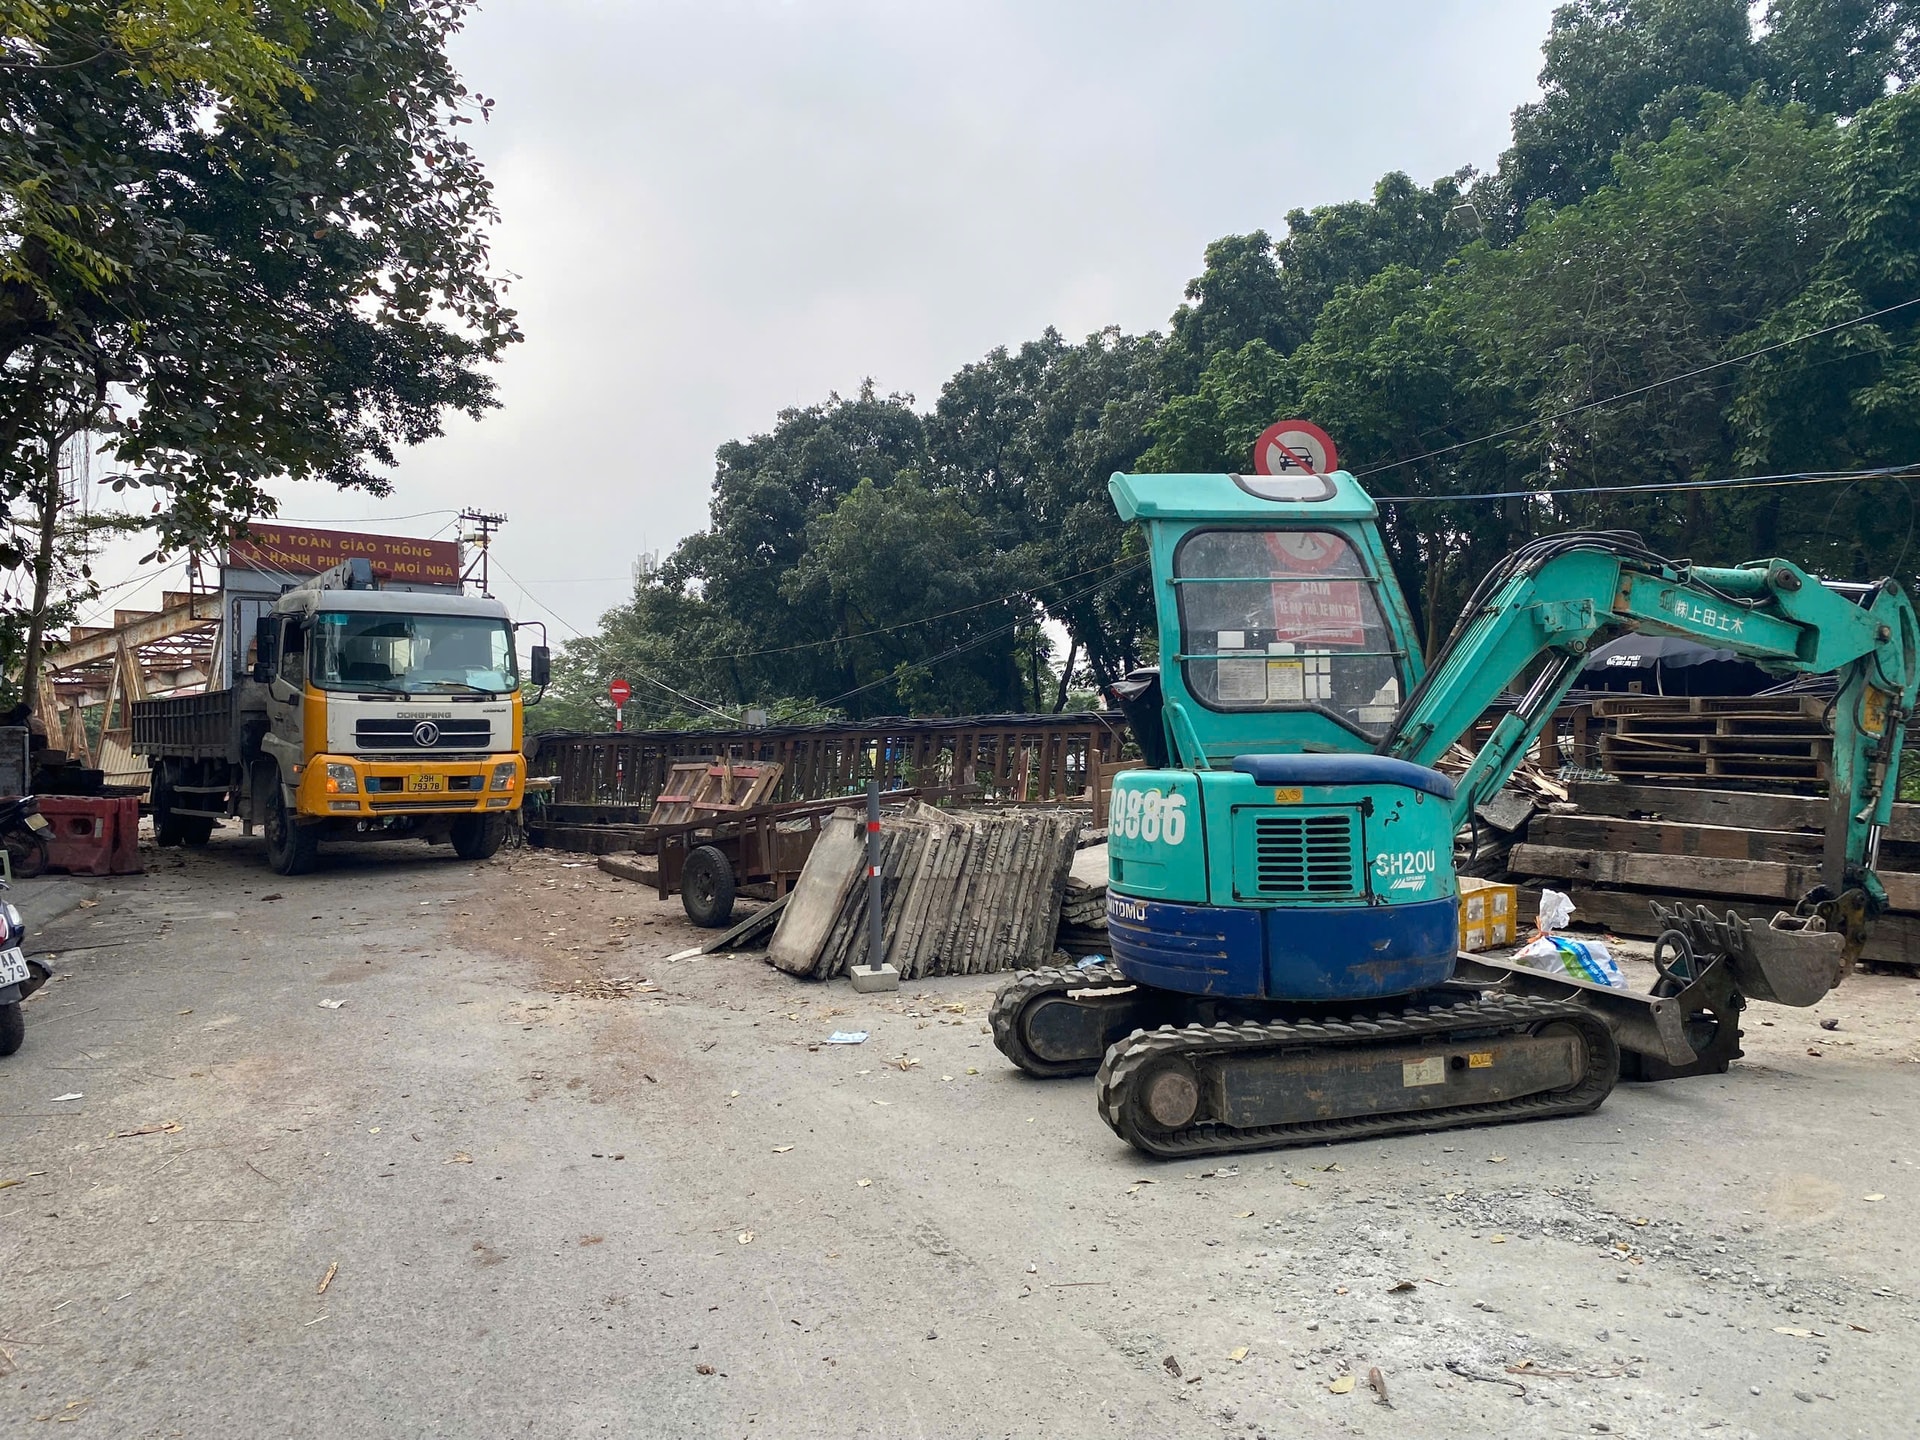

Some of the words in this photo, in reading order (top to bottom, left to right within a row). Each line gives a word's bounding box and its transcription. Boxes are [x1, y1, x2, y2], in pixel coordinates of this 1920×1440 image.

[289, 533, 332, 549] TOÀN
[384, 541, 432, 557] THÔNG
[270, 551, 310, 565] HẠNH
[317, 552, 346, 566] PHÚ
[369, 560, 387, 570] HO
[426, 563, 454, 577] NHÀ
[418, 775, 434, 783] 29H
[1376, 850, 1435, 876] SH20U
